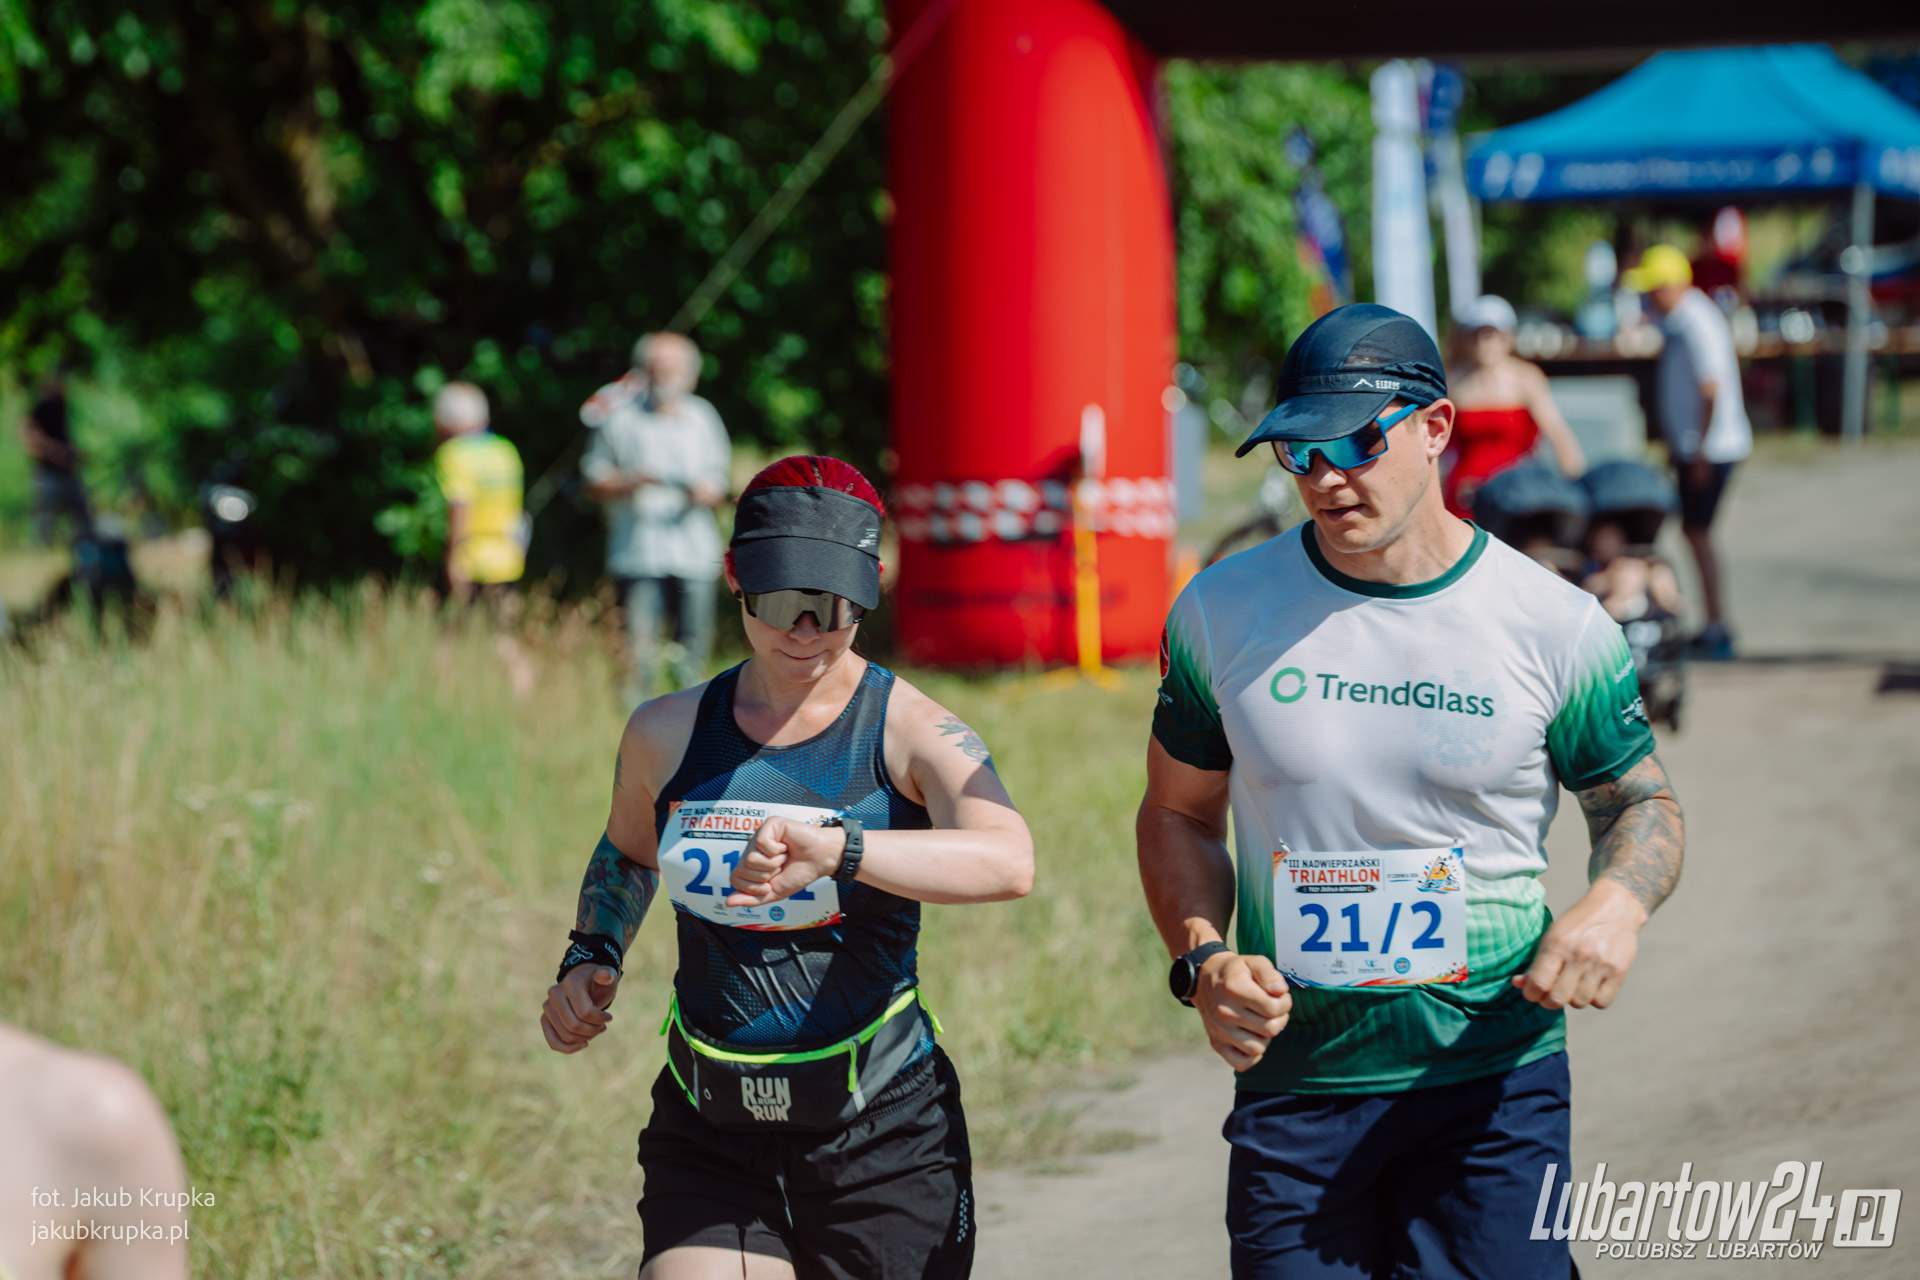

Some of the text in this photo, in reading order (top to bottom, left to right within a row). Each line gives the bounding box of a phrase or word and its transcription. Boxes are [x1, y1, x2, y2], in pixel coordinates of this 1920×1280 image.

[1316, 673, 1494, 717] TrendGlass
[680, 816, 763, 831] TRIATHLON
[1288, 857, 1380, 868] III NADWIEPRZAŃSKI
[1289, 869, 1380, 883] TRIATHLON
[1299, 901, 1444, 954] 21/2
[740, 1076, 792, 1105] RUN
[752, 1105, 789, 1122] RUN
